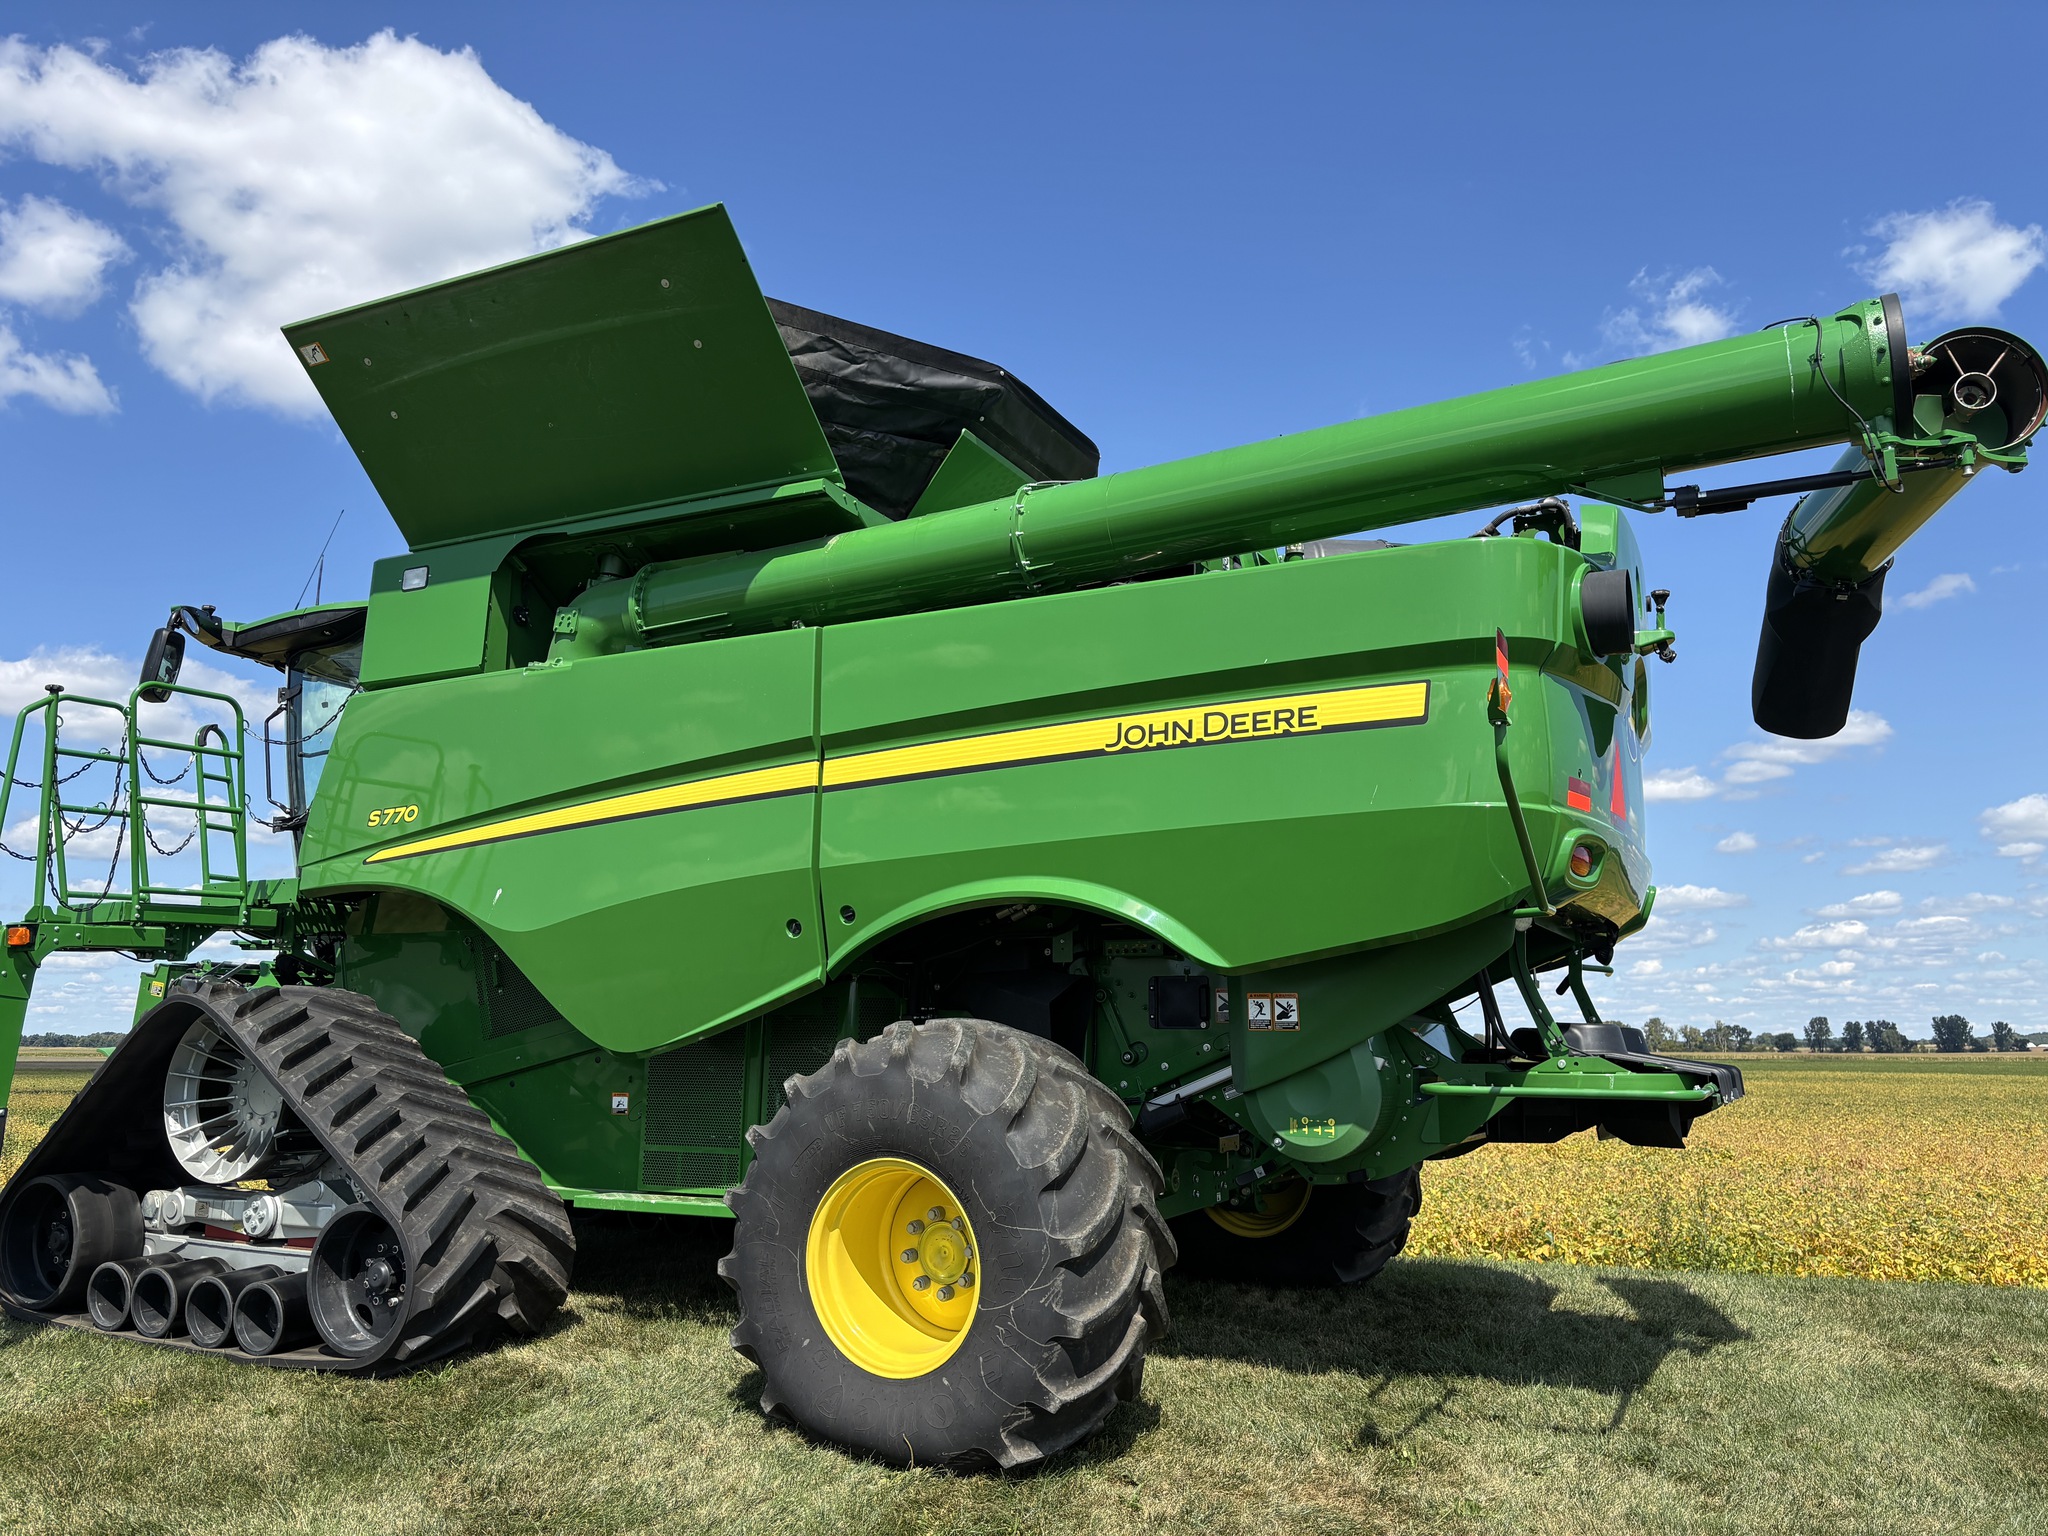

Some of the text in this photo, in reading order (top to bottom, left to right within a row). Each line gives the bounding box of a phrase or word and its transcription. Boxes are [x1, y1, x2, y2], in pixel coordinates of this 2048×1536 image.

[1105, 705, 1318, 748] JOHN DEERE
[367, 804, 419, 828] S770
[823, 1105, 847, 1132] VF
[758, 1251, 790, 1354] RADIAL
